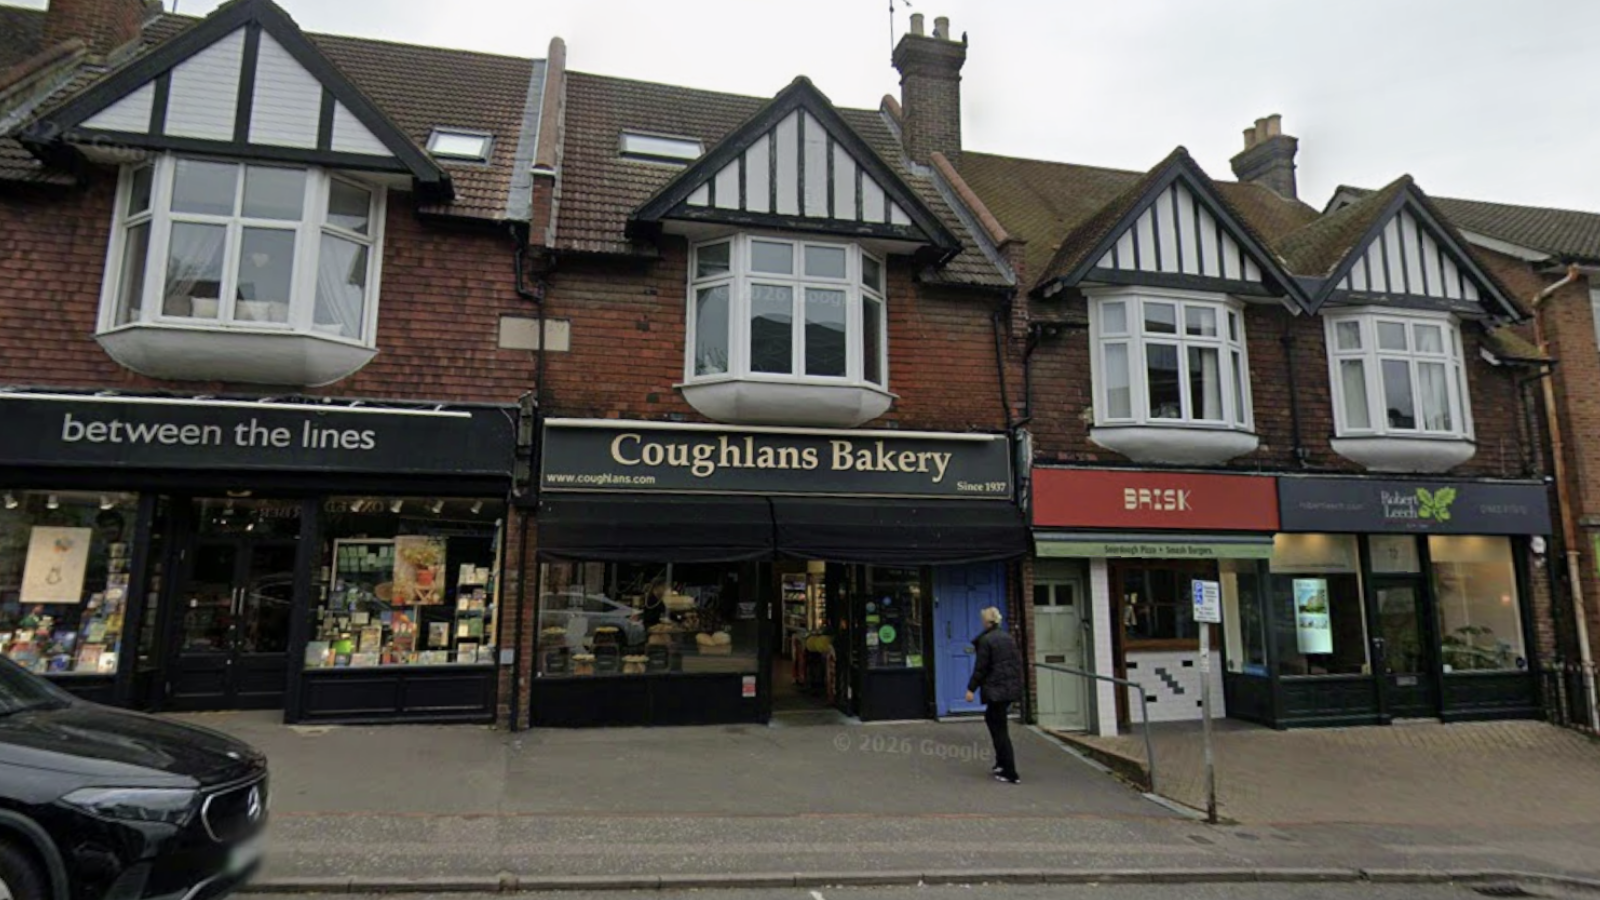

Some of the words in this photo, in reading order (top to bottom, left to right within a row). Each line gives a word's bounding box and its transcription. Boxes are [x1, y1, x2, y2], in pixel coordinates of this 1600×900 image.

[61, 413, 222, 446] between
[234, 418, 292, 448] the
[302, 419, 376, 450] lines
[611, 433, 819, 477] Coughlans
[829, 439, 952, 483] Bakery
[546, 473, 656, 485] www.coughlans.com
[957, 482, 984, 492] Since
[985, 482, 1007, 492] 1937
[1124, 488, 1193, 511] BRISK
[1380, 490, 1419, 505] Robert
[1384, 504, 1418, 518] Leech
